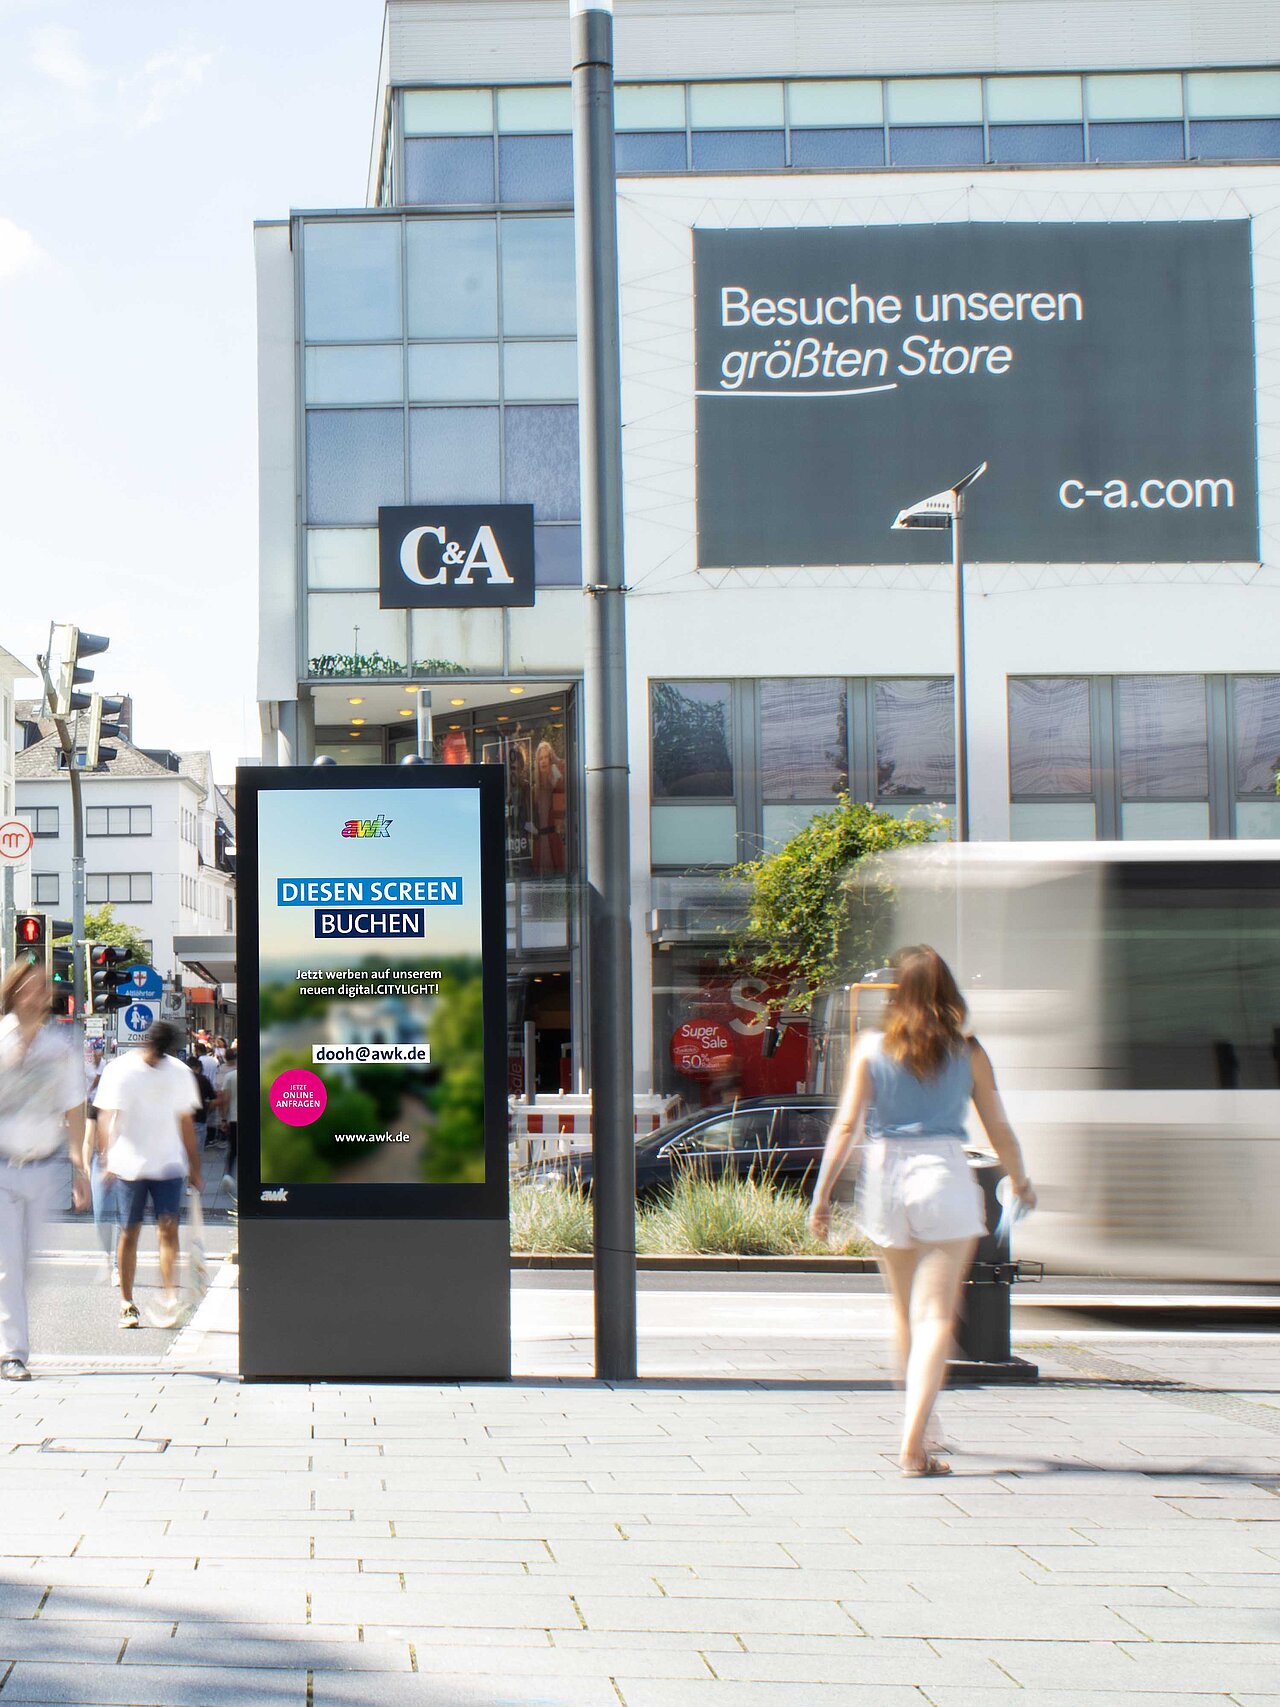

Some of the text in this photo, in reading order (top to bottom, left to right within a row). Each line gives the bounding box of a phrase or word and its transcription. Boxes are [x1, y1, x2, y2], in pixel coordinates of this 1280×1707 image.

[721, 283, 1083, 327] Besuche unseren
[719, 335, 1013, 390] größten Store
[1058, 478, 1234, 509] c-a.com
[400, 525, 515, 586] C&A
[341, 814, 394, 838] awk
[282, 881, 457, 902] DIESEN SCREEN
[321, 913, 419, 934] BUCHEN
[295, 969, 442, 981] Jetzt werben auf unserem
[299, 984, 440, 998] neuen digital.CITYLIGHT!
[127, 1033, 151, 1041] ZONE
[681, 1024, 719, 1039] Super
[701, 1036, 728, 1049] Sale
[316, 1046, 426, 1062] dooh@awk.de
[282, 1091, 314, 1099] ONLINE
[275, 1099, 321, 1108] ANFRAGEN
[334, 1131, 410, 1143] www.awk.de
[260, 1187, 289, 1202] awk
